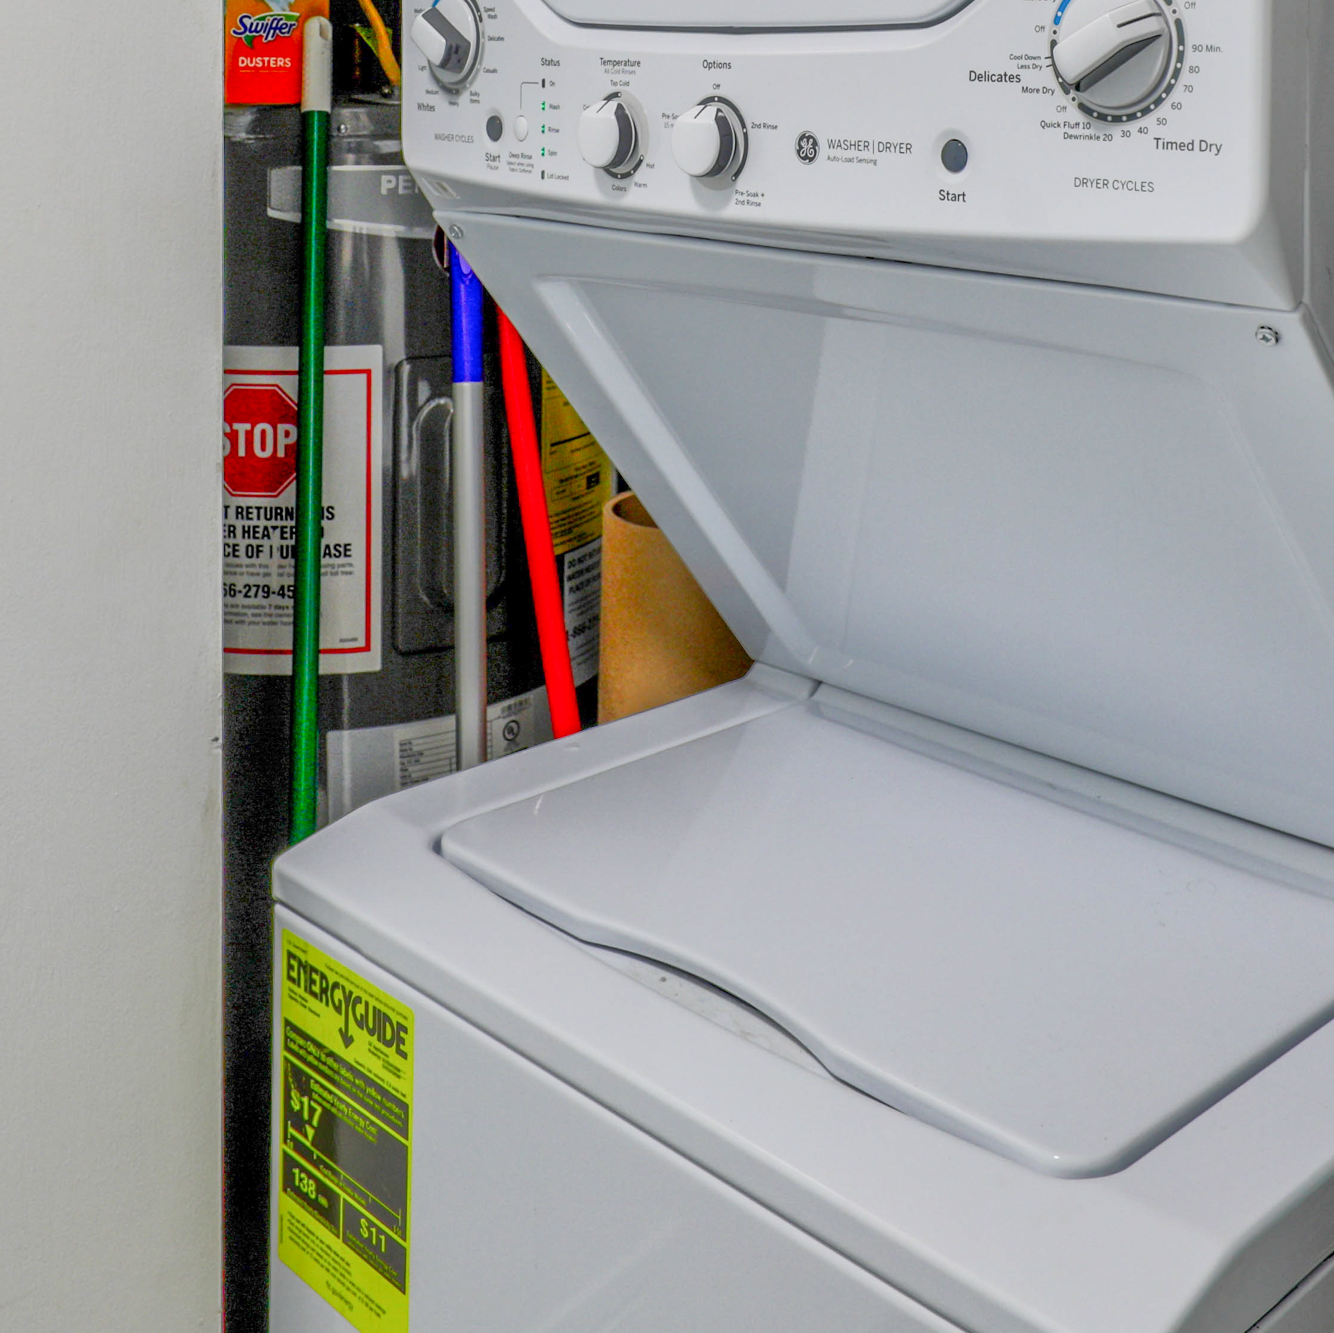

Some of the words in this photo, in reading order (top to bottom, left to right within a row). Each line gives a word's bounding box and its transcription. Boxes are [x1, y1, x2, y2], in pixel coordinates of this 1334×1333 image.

[1184, 1, 1196, 10] Off
[231, 14, 297, 42] Swiffer
[1034, 25, 1045, 33] Off
[1191, 45, 1203, 53] 90
[1205, 44, 1223, 53] Min.
[238, 56, 292, 68] DUSTERS
[540, 57, 561, 67] Status
[599, 57, 641, 68] Temperature
[702, 59, 732, 71] Options
[1032, 63, 1043, 71] Dry
[1188, 66, 1200, 74] 80
[969, 70, 1021, 83] Delicates
[1021, 86, 1040, 94] More
[1042, 87, 1056, 96] Dry
[1183, 85, 1193, 93] 70
[417, 102, 436, 112] Whites
[1056, 105, 1068, 113] Off
[1171, 102, 1182, 110] 60
[751, 122, 762, 130] 2nd
[763, 122, 779, 130] Rinse
[1040, 120, 1062, 130] Quick
[1063, 121, 1080, 129] Fluff
[1082, 121, 1091, 130] 10
[1156, 118, 1167, 126] 50
[1120, 130, 1131, 138] 30
[1137, 127, 1149, 135] 40
[434, 133, 455, 142] WASHER
[454, 134, 474, 143] CYCLES
[1063, 132, 1101, 142] Dewrinkle
[1102, 134, 1113, 142] 20
[826, 138, 870, 152] WASHER
[877, 141, 913, 154] DRYER
[1153, 137, 1194, 152] Timed
[1198, 140, 1223, 156] Dry
[485, 152, 501, 163] Start
[826, 155, 855, 164] Auto-Load
[855, 156, 878, 166] Sensing
[611, 184, 627, 192] Colors
[1074, 177, 1109, 190] DRYER
[1112, 180, 1154, 193] CYCLES
[735, 189, 759, 198] Pre-Soak
[939, 189, 967, 203] Start
[735, 198, 746, 206] 2nd
[746, 199, 762, 207] Rinse
[235, 506, 295, 521] RETURN
[245, 543, 264, 559] OF
[286, 949, 408, 1061] ENERGYGUIDE
[290, 1089, 323, 1128] $17
[292, 1168, 316, 1200] 138
[360, 1218, 386, 1253] $11
